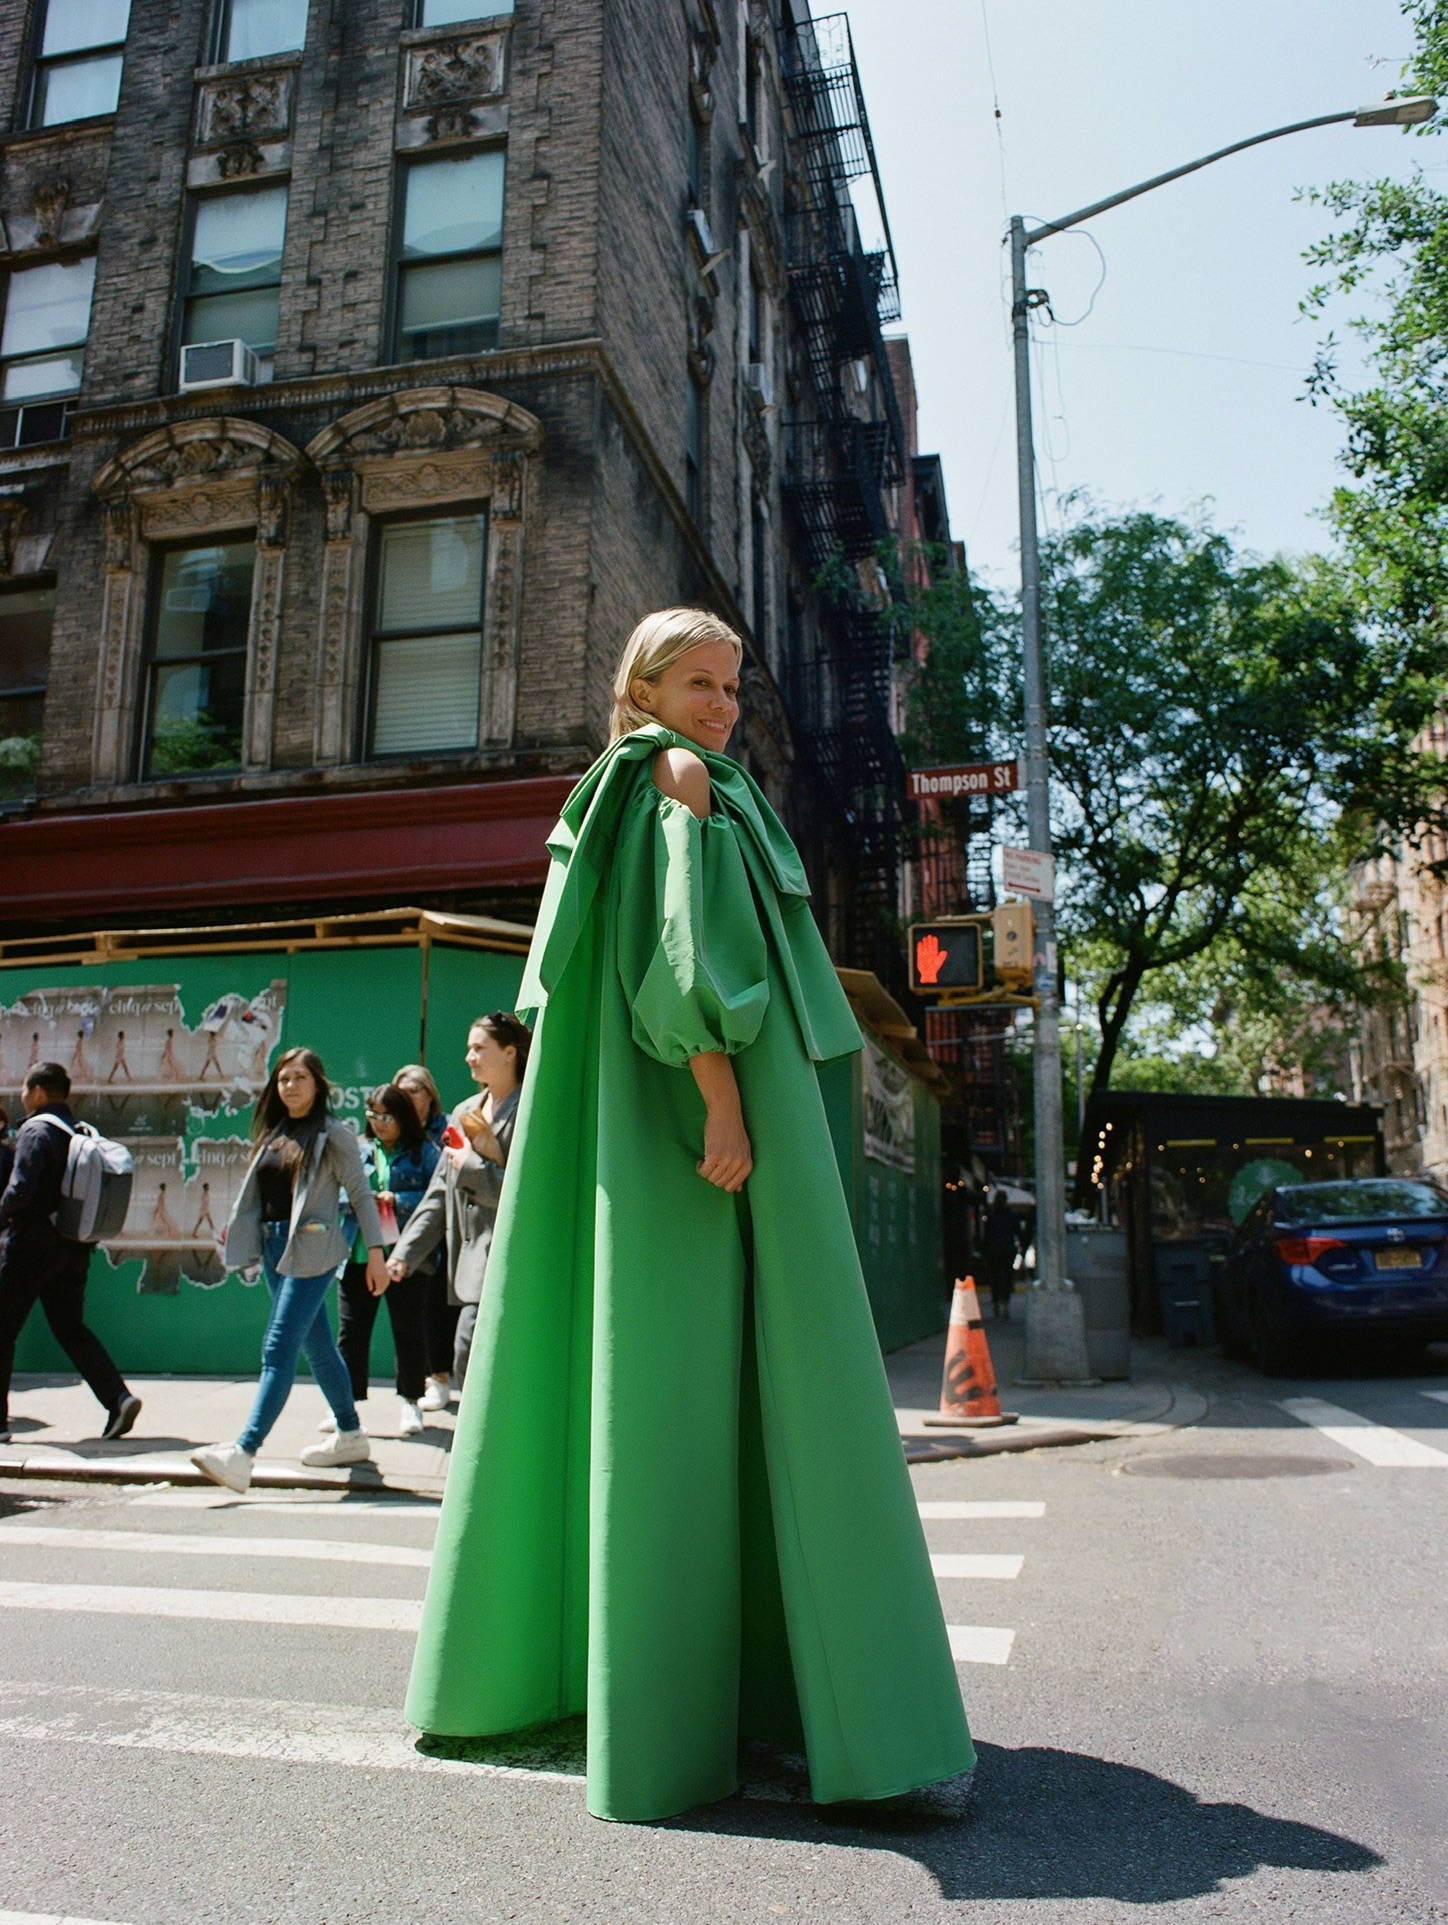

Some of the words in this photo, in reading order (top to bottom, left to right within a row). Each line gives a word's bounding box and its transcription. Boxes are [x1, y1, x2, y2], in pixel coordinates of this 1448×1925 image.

[911, 773, 988, 797] Thompson
[993, 766, 1012, 789] St
[326, 1085, 375, 1110] OST
